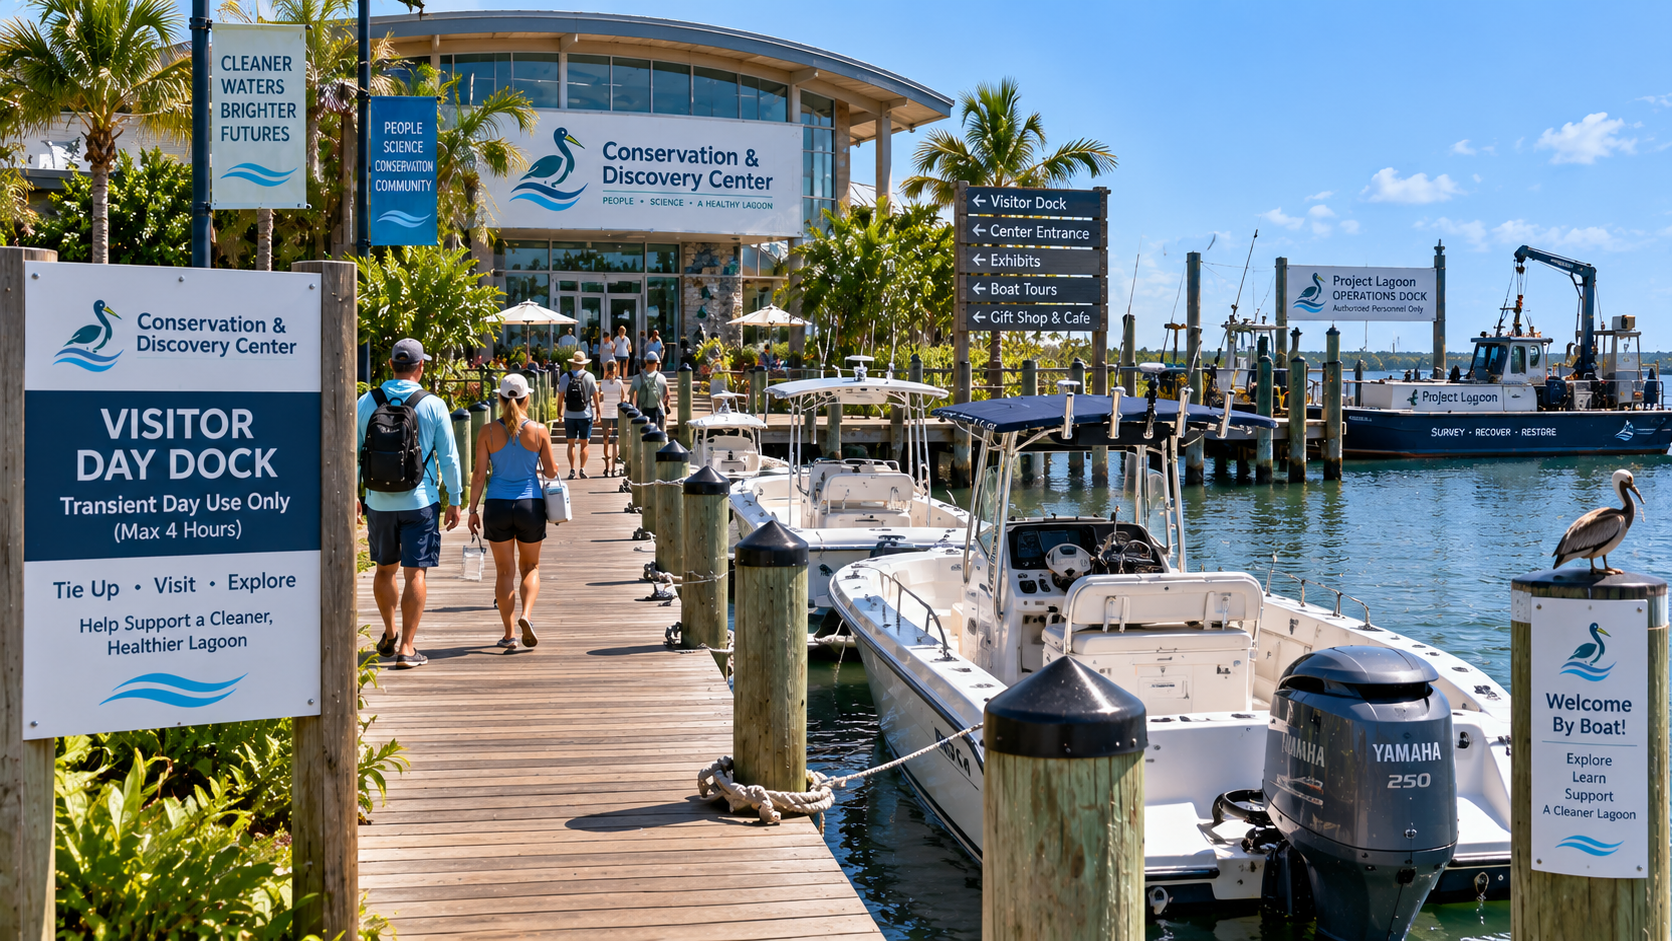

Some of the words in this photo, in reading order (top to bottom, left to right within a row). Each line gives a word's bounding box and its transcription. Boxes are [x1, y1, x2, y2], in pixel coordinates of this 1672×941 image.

[220, 55, 292, 72] CLEANER
[220, 79, 285, 95] WATERS
[220, 102, 297, 119] BRIGHTER
[220, 126, 290, 142] FUTURES
[384, 121, 423, 135] PEOPLE
[383, 141, 424, 154] SCIENCE
[602, 141, 738, 166] Conservation
[745, 149, 759, 167] &
[374, 159, 434, 172] CONSERVATION
[375, 179, 432, 192] COMMUNITY
[602, 165, 703, 192] Discovery
[708, 169, 773, 190] Center
[602, 196, 634, 205] PEOPLE
[650, 198, 684, 207] SCIENCE
[697, 200, 704, 208] A
[706, 200, 740, 209] HEALTHY
[742, 202, 773, 210] LAGOON
[990, 194, 1031, 209] Visitor
[1036, 196, 1067, 210] Dock
[990, 224, 1032, 238] Center
[1036, 226, 1090, 239] Entrance
[990, 253, 1041, 268] Exhibits
[990, 282, 1019, 295] Boat
[1024, 282, 1057, 295] Tours
[1333, 275, 1373, 289] Project
[1376, 276, 1416, 289] Lagoon
[1332, 290, 1396, 301] OPERATIONS
[1399, 291, 1428, 301] DOCK
[136, 312, 266, 333] Conservation
[272, 318, 287, 334] &
[990, 310, 1013, 324] Gift
[1017, 311, 1048, 327] Shop
[1051, 312, 1061, 324] &
[1064, 311, 1090, 324] Cafe
[136, 335, 230, 358] Discovery
[235, 338, 297, 355] Center
[1422, 390, 1458, 405] Project
[100, 408, 255, 440] VISITOR
[1431, 427, 1466, 437] SURVEY
[1475, 427, 1511, 437] RECOVER
[76, 449, 157, 482] DAY
[169, 447, 278, 480] DOCK
[59, 496, 157, 516] Transient
[163, 495, 200, 517] Day
[205, 494, 242, 512] Use
[247, 491, 291, 514] Only
[113, 522, 160, 543] (Max
[165, 522, 178, 539] 4
[183, 518, 243, 541] Hours)
[53, 581, 84, 600] Tie
[90, 580, 120, 602] Up
[154, 576, 196, 595] Visit
[227, 572, 297, 593] Explore
[79, 617, 119, 634] Help
[124, 613, 192, 633] Support
[196, 615, 205, 627] a
[210, 609, 274, 628] Cleaner,
[107, 638, 184, 656] Healthier
[188, 634, 248, 654] Lagoon
[1545, 692, 1632, 713] Welcome
[1552, 716, 1575, 737] By
[1580, 718, 1627, 736] Boat!
[1372, 741, 1442, 763] YAMAHA
[1566, 752, 1613, 768] Explore
[1386, 772, 1432, 789] 250
[1572, 771, 1607, 784] Learn
[1564, 788, 1614, 804] Support
[1542, 804, 1551, 815] A
[1553, 805, 1594, 819] Cleaner
[1597, 809, 1637, 821] Lagoon
